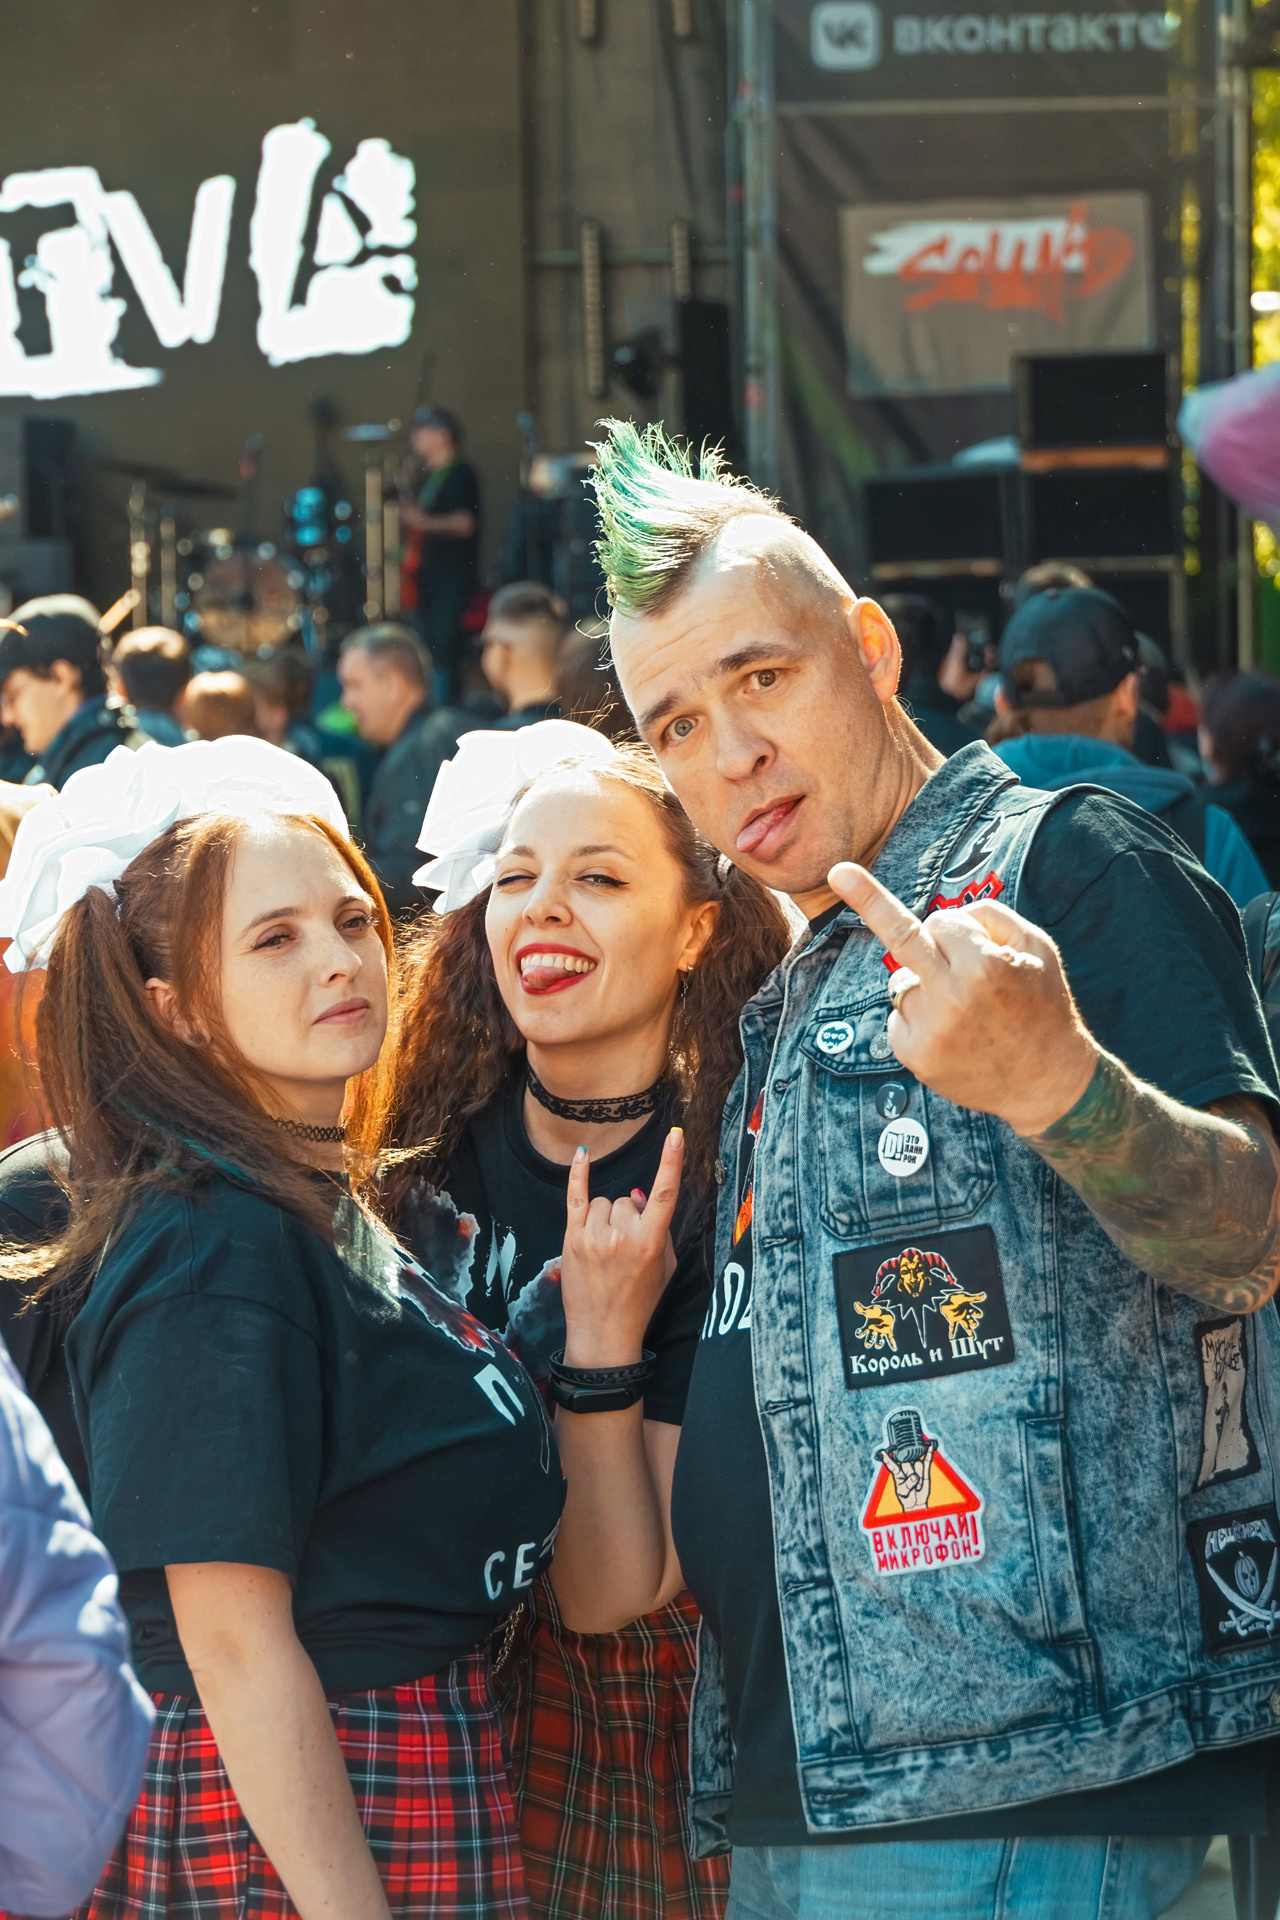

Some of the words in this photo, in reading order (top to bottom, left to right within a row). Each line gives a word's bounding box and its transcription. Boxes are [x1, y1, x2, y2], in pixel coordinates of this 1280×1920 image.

[905, 1134, 920, 1144] ЭТО
[904, 1144, 923, 1155] ПАНК
[903, 1154, 917, 1164] РОК
[850, 1352, 923, 1376] Король
[929, 1347, 943, 1362] и
[949, 1336, 1004, 1360] Шут
